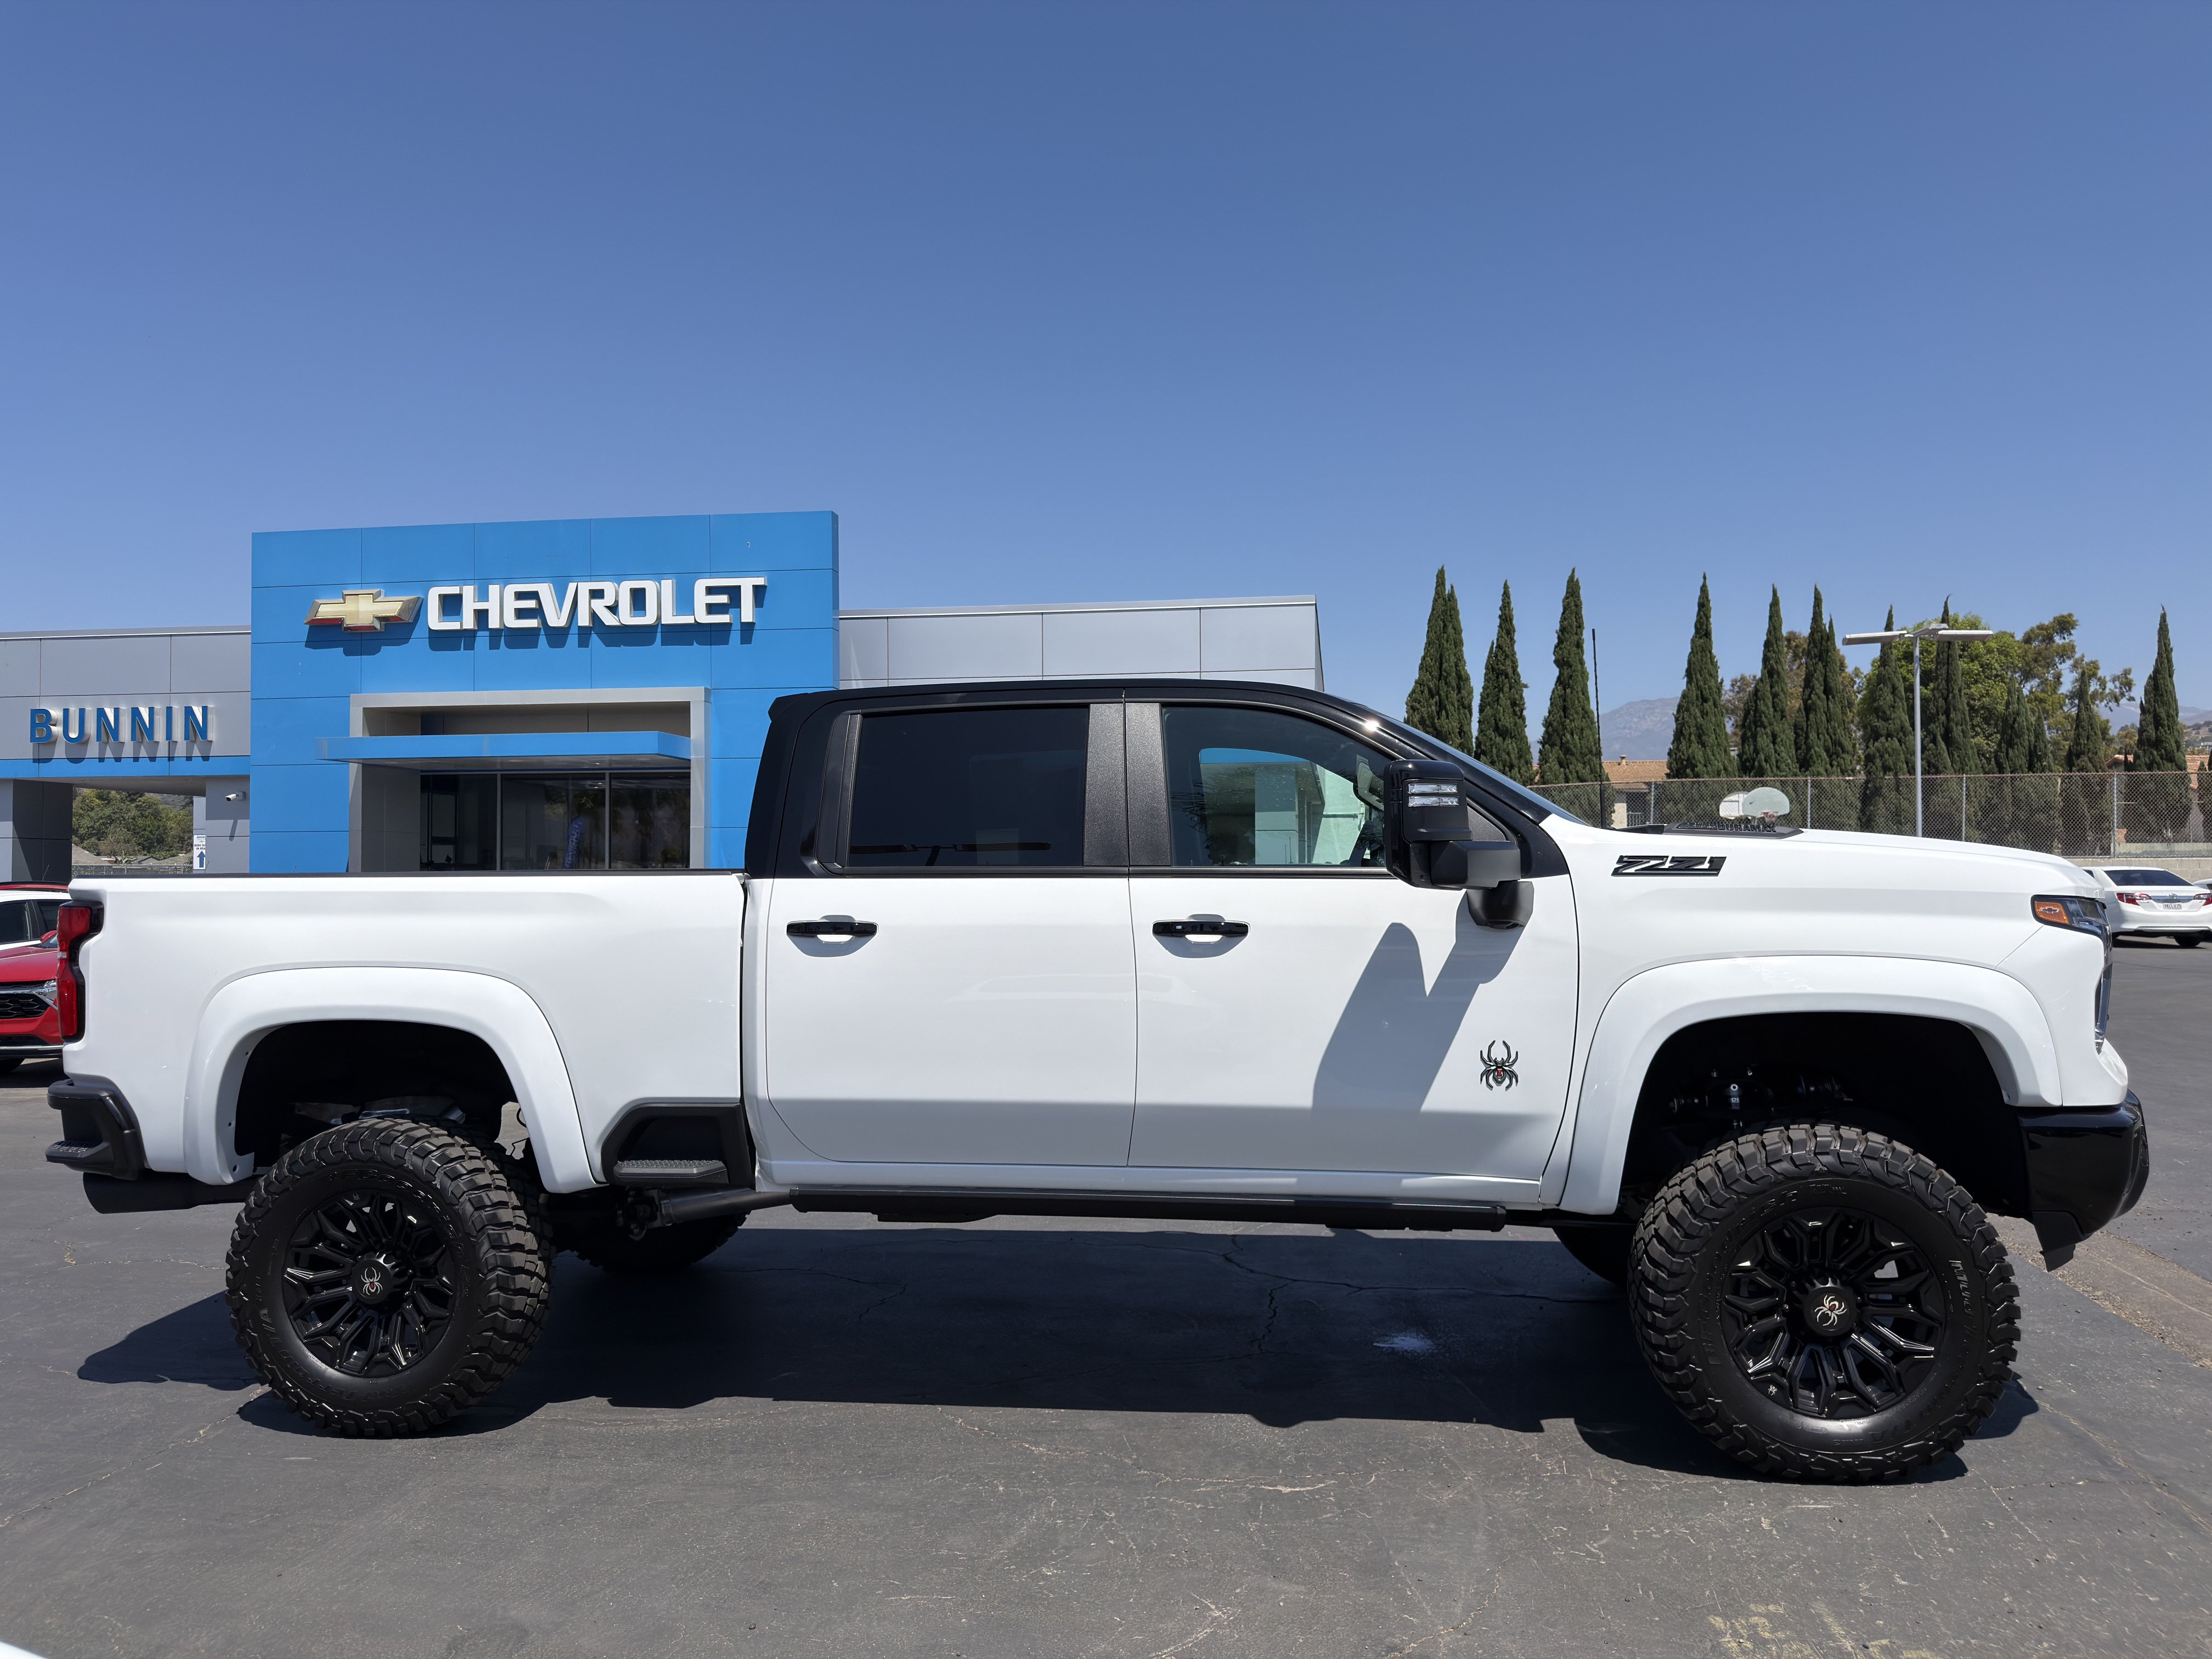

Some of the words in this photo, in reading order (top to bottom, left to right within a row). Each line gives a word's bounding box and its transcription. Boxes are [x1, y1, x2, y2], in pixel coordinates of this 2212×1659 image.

[428, 577, 766, 630] CHEVROLET
[30, 706, 212, 743] BUNNIN
[1718, 823, 1776, 833] DURAMAX
[1611, 855, 1727, 877] Z71
